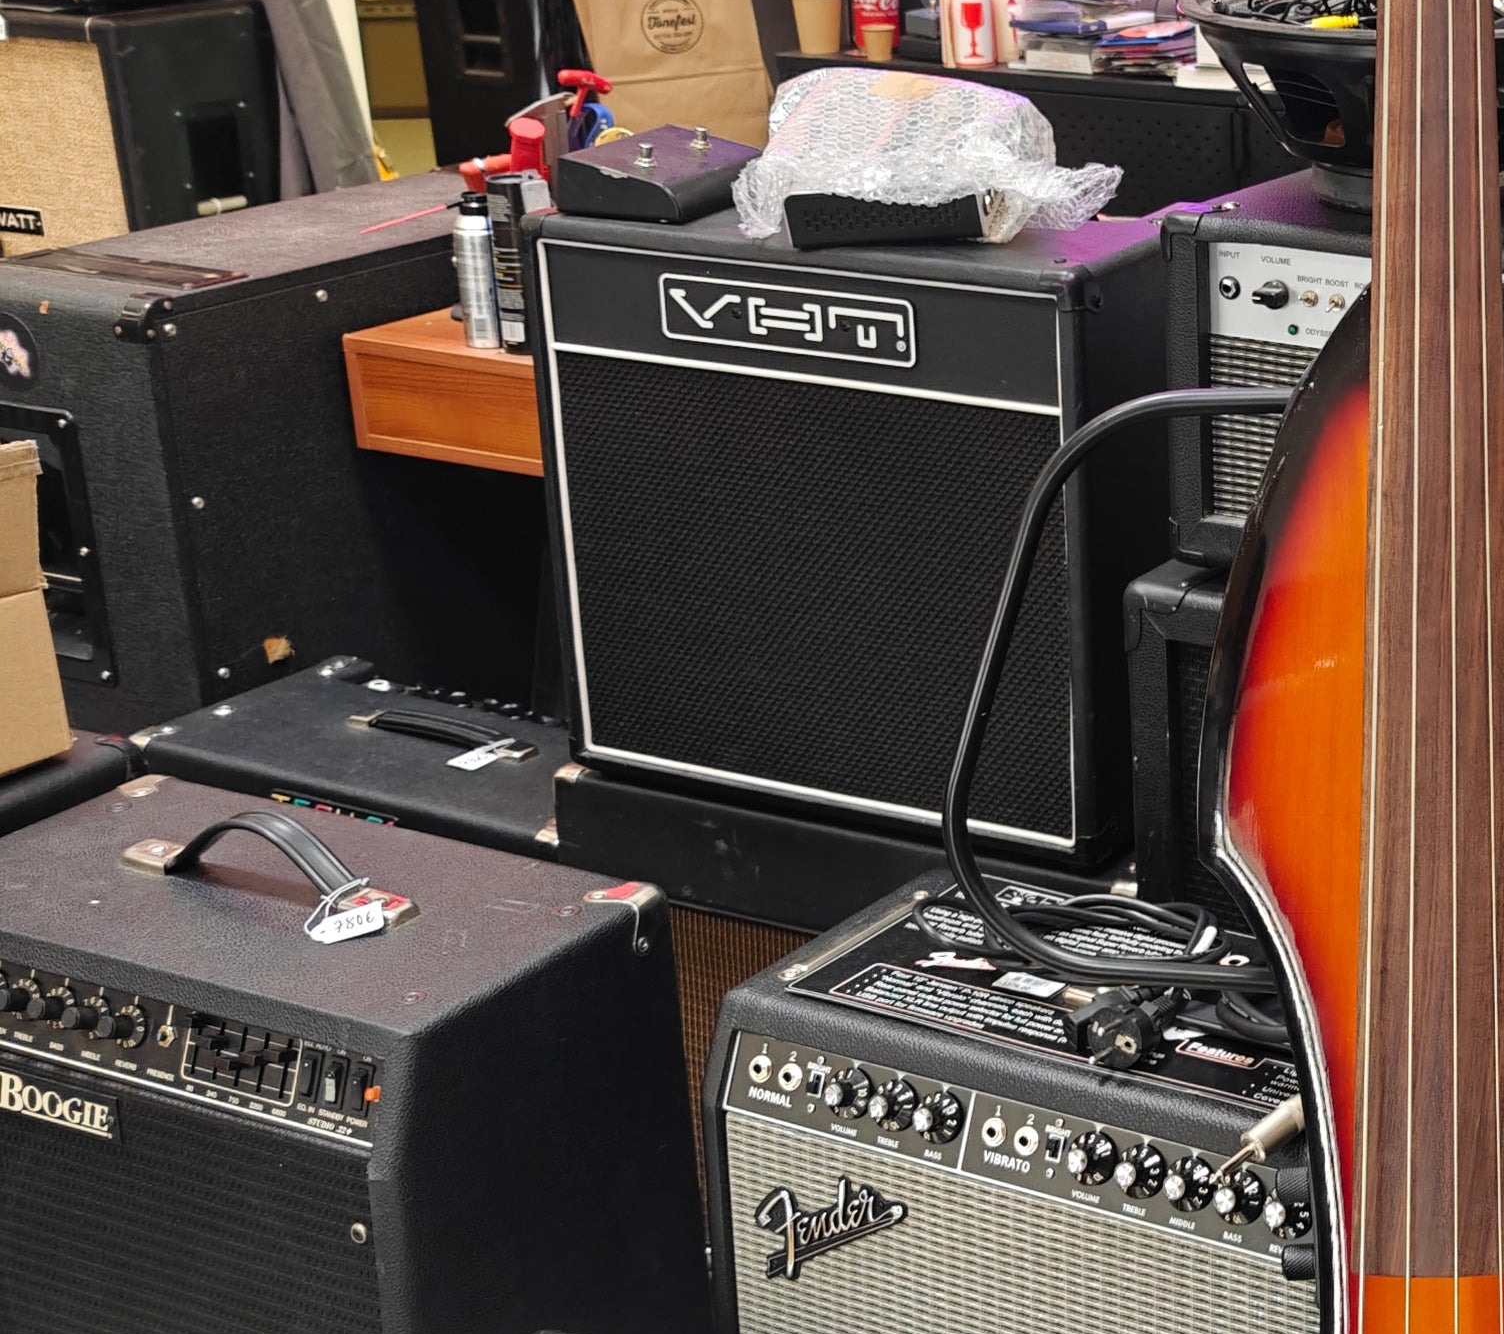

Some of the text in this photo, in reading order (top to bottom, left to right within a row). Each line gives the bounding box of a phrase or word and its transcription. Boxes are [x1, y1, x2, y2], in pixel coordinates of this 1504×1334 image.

[1218, 250, 1240, 260] INPUT
[1260, 255, 1292, 266] VOLUME
[1296, 275, 1322, 286] BRIGHT
[1324, 278, 1349, 288] BOOST
[1305, 328, 1332, 338] ODYSSE
[789, 1050, 797, 1062] 2
[1187, 1041, 1255, 1065] Features
[0, 1071, 109, 1131] BOOGIE
[748, 1086, 792, 1109] NORMAL
[307, 1118, 335, 1131] STUDIO
[1026, 1113, 1035, 1125] 2
[831, 1122, 858, 1138] VOLUME
[877, 1136, 900, 1149] TREBLE
[923, 1149, 943, 1160] BASS
[983, 1149, 1030, 1173] VIBRATO
[1071, 1189, 1101, 1204] VOLUME
[1122, 1203, 1147, 1217] TREBLE
[753, 1175, 908, 1280] Fender
[1169, 1216, 1196, 1231] MIDDLE
[1222, 1230, 1242, 1244] BASS
[1269, 1243, 1284, 1255] REV
